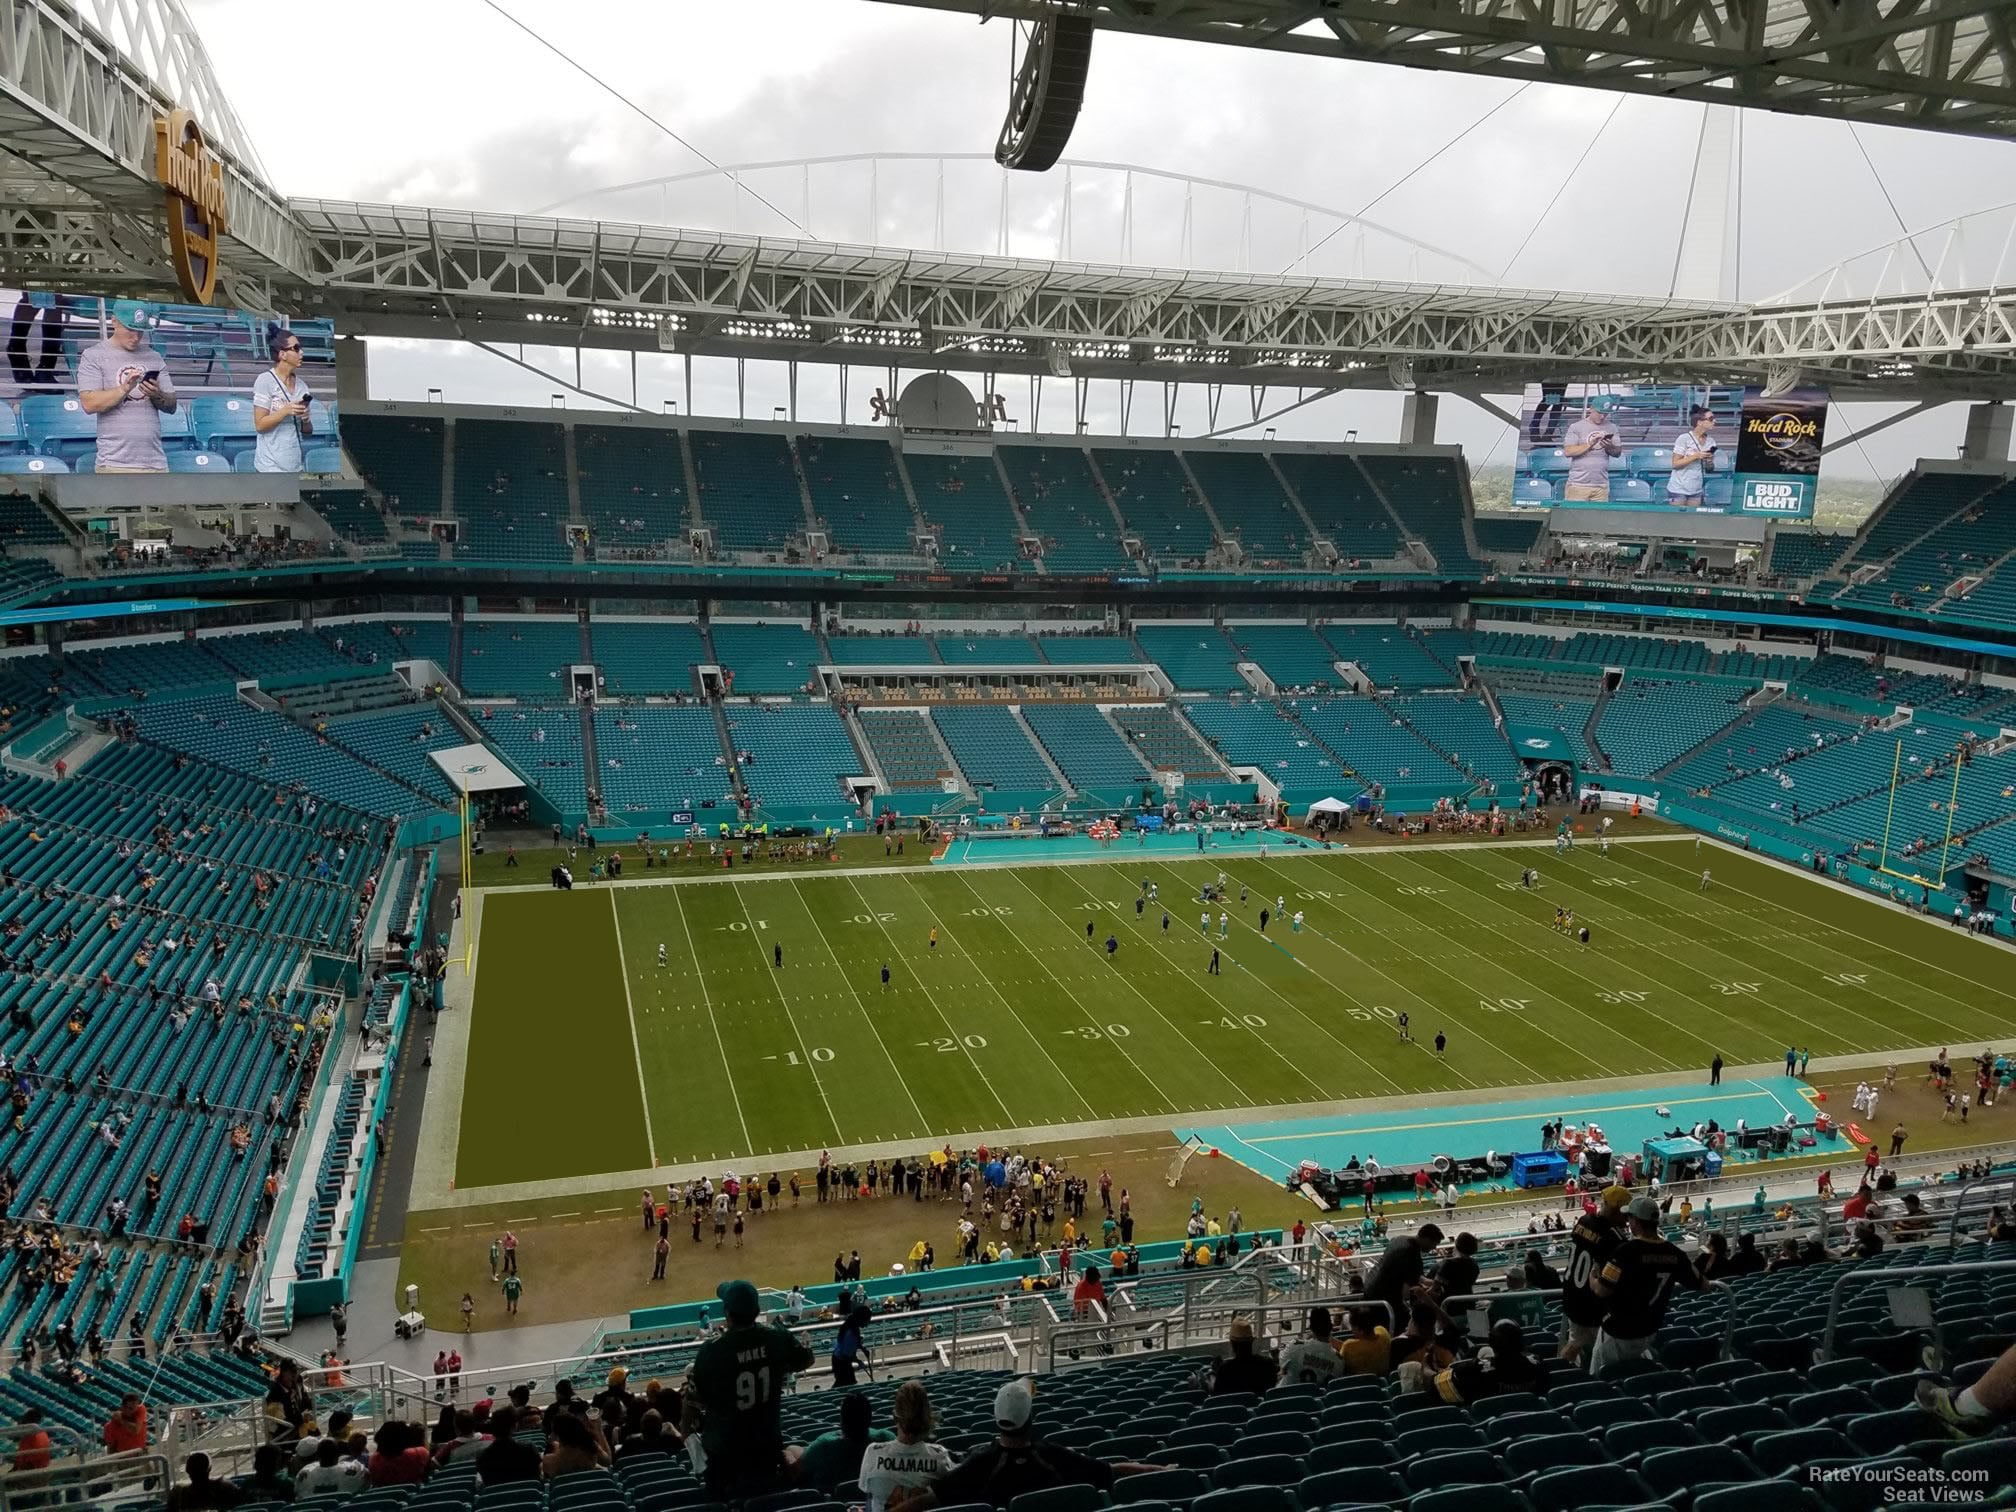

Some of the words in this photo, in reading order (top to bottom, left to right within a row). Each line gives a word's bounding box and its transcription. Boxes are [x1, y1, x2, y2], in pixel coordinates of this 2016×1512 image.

[1748, 420, 1782, 433] Hard
[1783, 420, 1816, 436] Rock
[1755, 484, 1792, 496] BUD
[1746, 496, 1798, 509] LIGHT
[1296, 890, 1333, 901] 40
[1396, 886, 1436, 896] 30
[972, 906, 1014, 917] 30
[1083, 900, 1122, 911] 40
[729, 919, 770, 932] 10
[854, 913, 898, 924] 20
[1822, 973, 1867, 987] 10
[1710, 981, 1759, 995] 20
[1594, 990, 1646, 1004] 30
[1478, 998, 1525, 1013] 40
[1345, 1005, 1398, 1022] 50
[1219, 1014, 1268, 1032] 40
[1077, 1023, 1131, 1040] 30
[933, 1034, 987, 1052] 20
[783, 1048, 835, 1065] 10
[1648, 1272, 1672, 1306] 7
[737, 1347, 767, 1363] WAKE
[736, 1366, 770, 1411] 91
[876, 1456, 938, 1473] POLAMALU
